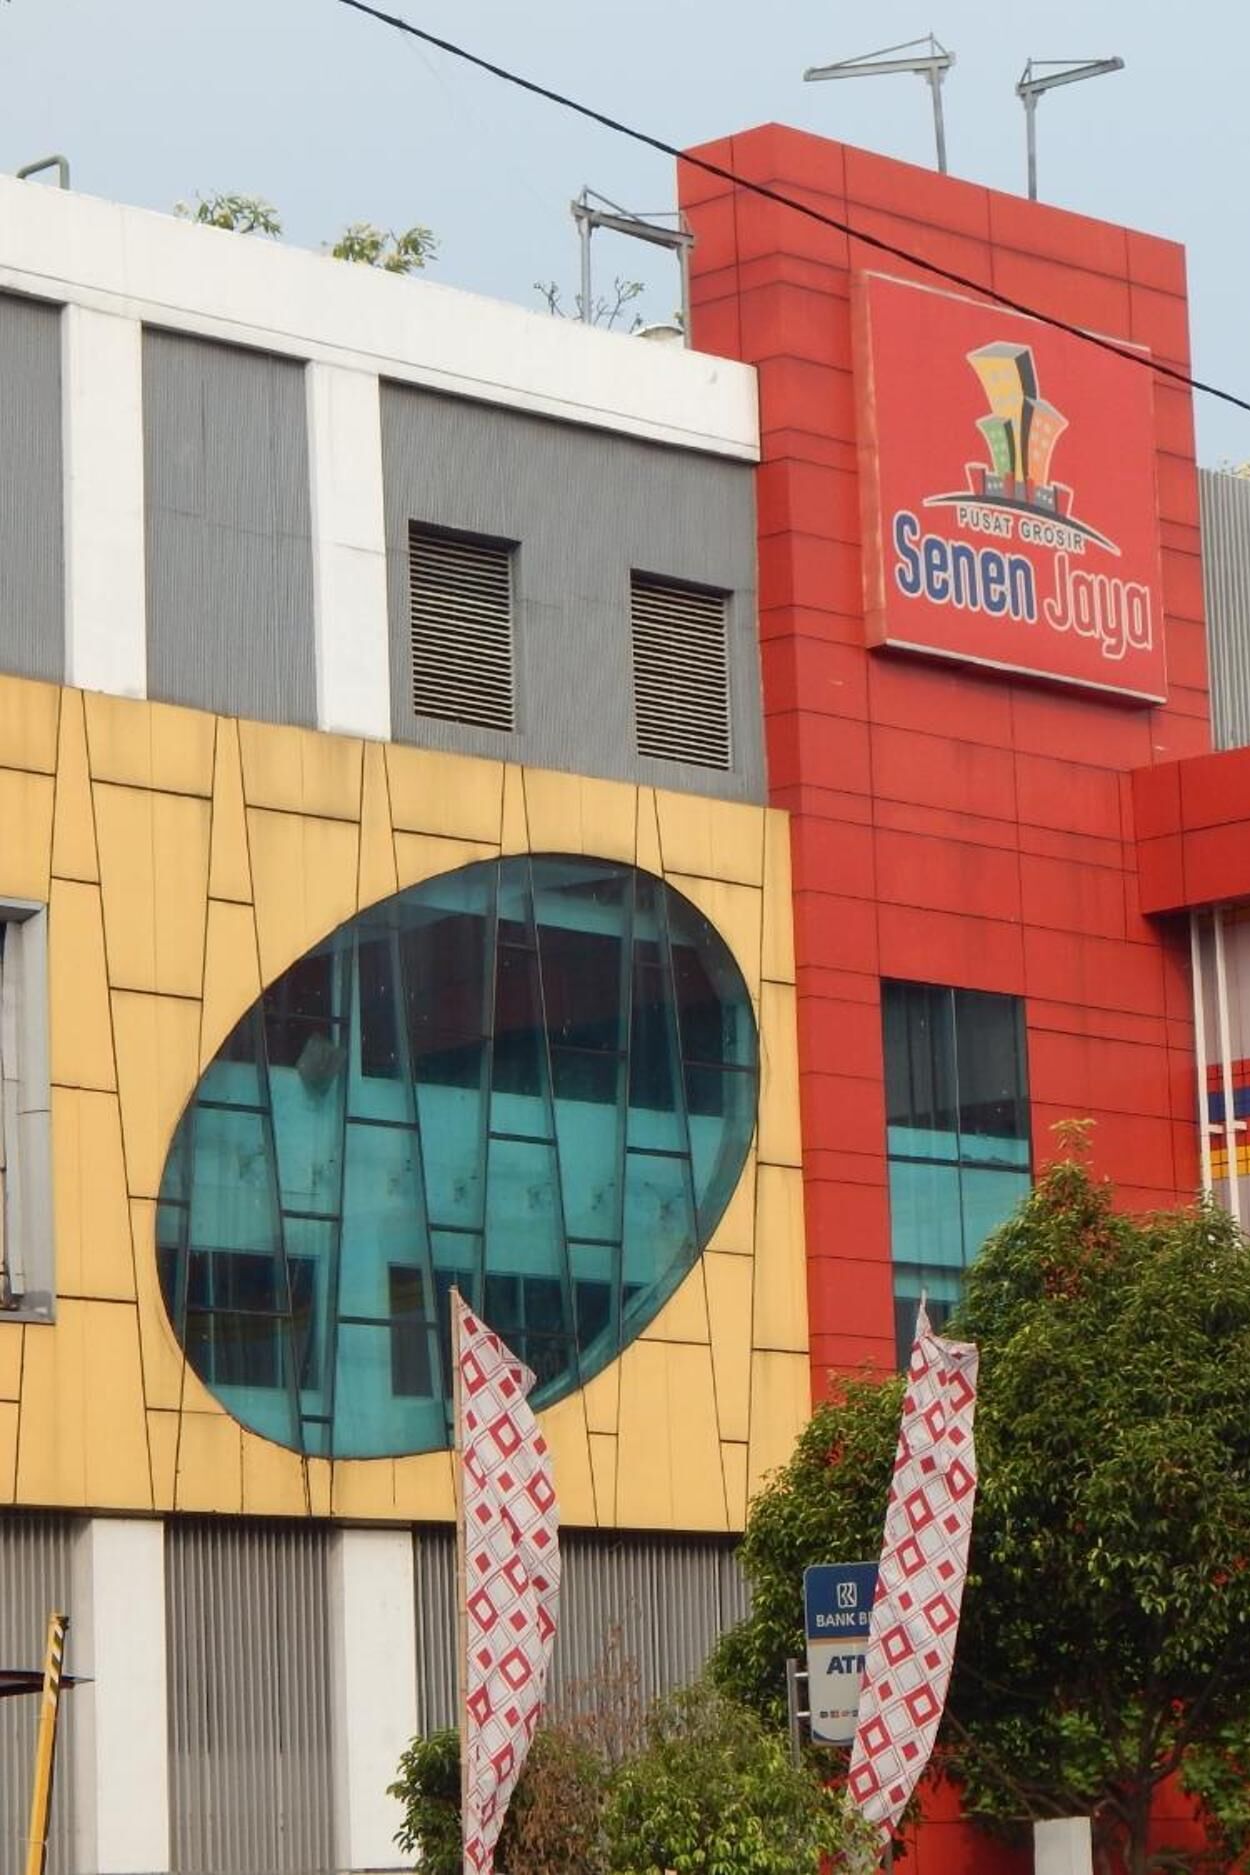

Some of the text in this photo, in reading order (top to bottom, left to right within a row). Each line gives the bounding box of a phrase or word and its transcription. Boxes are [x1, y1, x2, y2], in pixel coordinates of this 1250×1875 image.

[956, 505, 1086, 554] PUSAT GROSIR
[893, 510, 1152, 660] Senen Jaya
[816, 1612, 856, 1628] BANK
